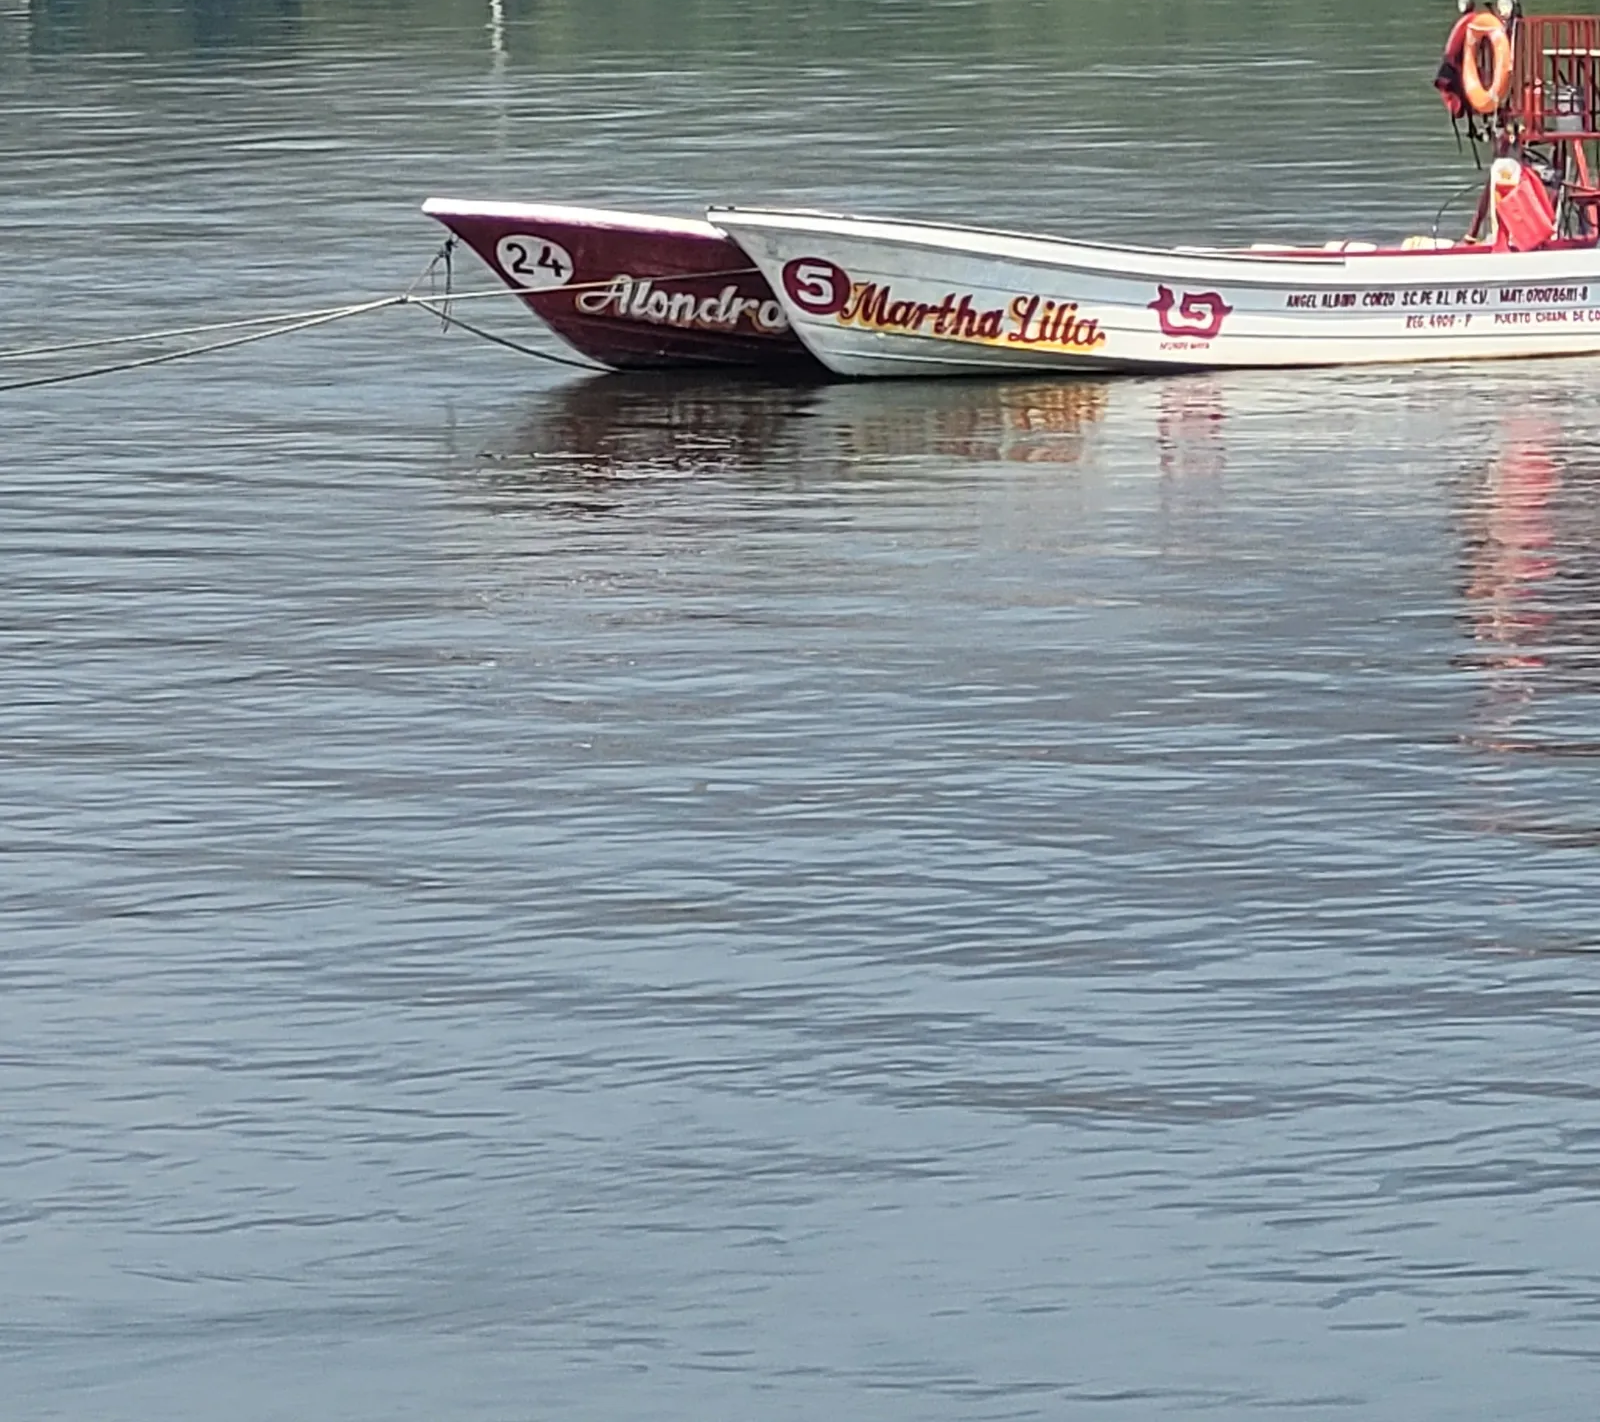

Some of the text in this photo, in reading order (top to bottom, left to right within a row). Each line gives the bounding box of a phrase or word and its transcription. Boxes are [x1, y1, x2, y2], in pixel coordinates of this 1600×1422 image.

[506, 242, 565, 278] 24
[579, 275, 788, 331] Alondra
[796, 265, 834, 306] 5
[1286, 294, 1317, 309] ANGEL
[841, 281, 1004, 340] Martha
